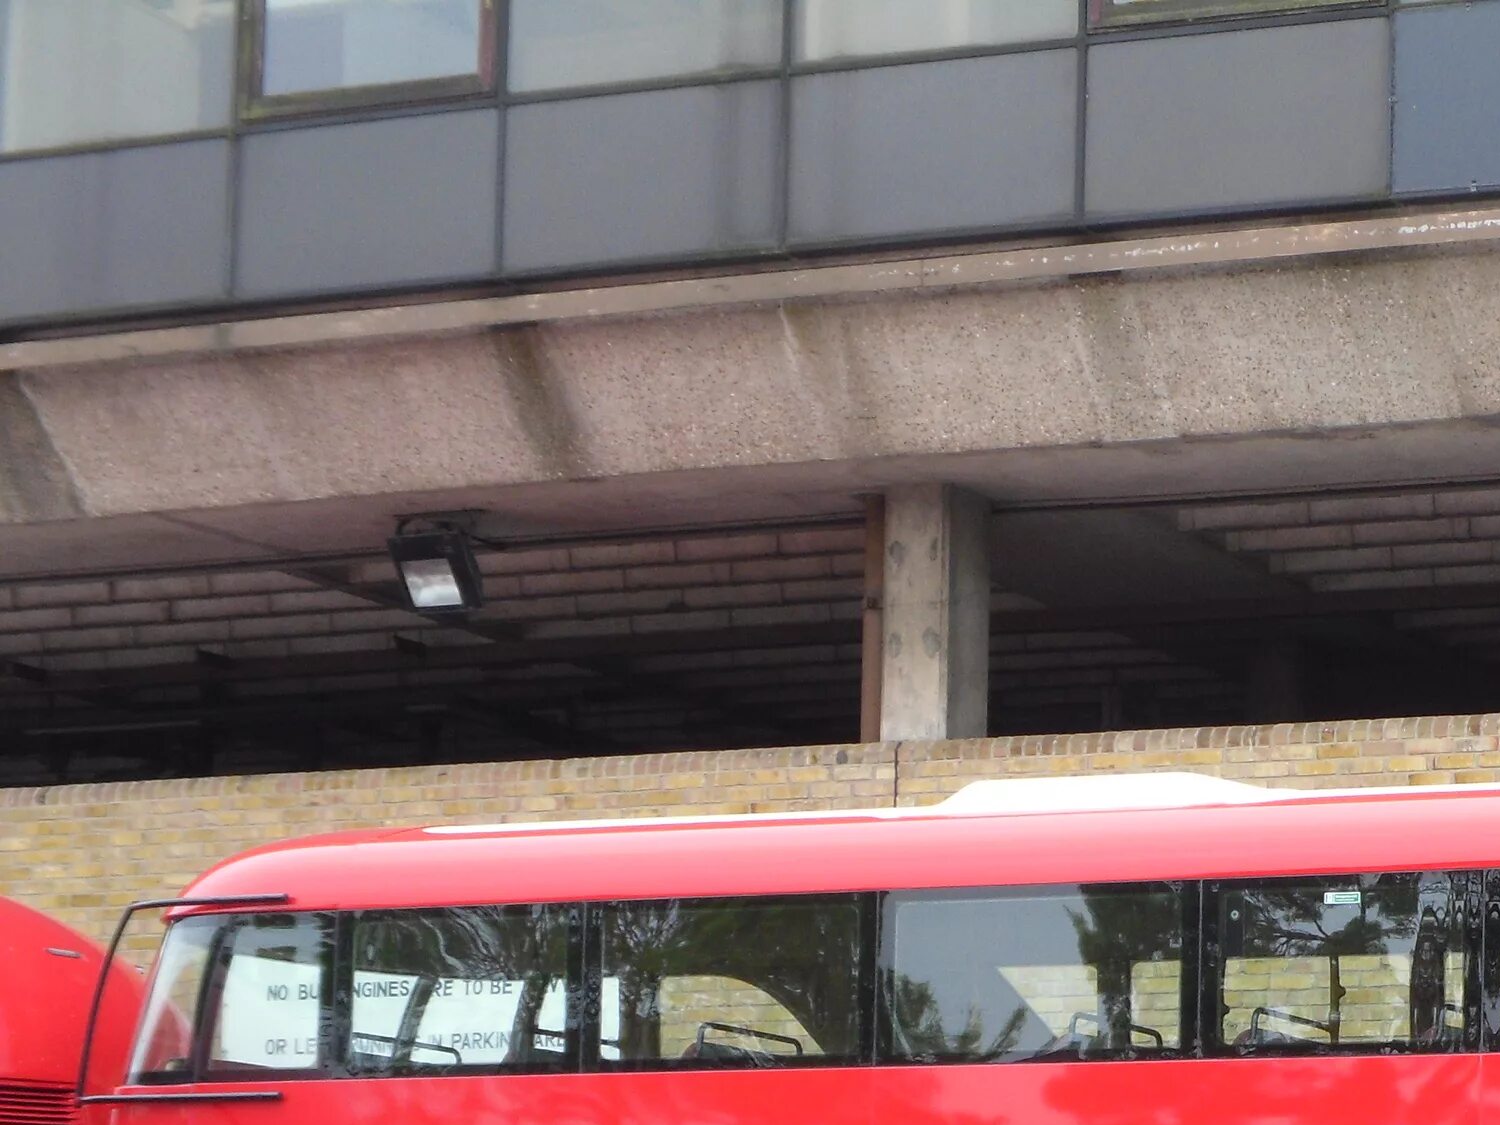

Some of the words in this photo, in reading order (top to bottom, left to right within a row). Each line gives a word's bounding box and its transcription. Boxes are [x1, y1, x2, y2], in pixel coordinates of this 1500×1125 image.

[267, 984, 288, 1000] NO
[299, 984, 320, 1000] BU
[351, 981, 410, 998] NGINES
[430, 980, 453, 997] RE
[465, 981, 483, 996] TO
[490, 981, 513, 995] BE
[265, 1039, 286, 1055] OR
[451, 1032, 511, 1050] PARKIN
